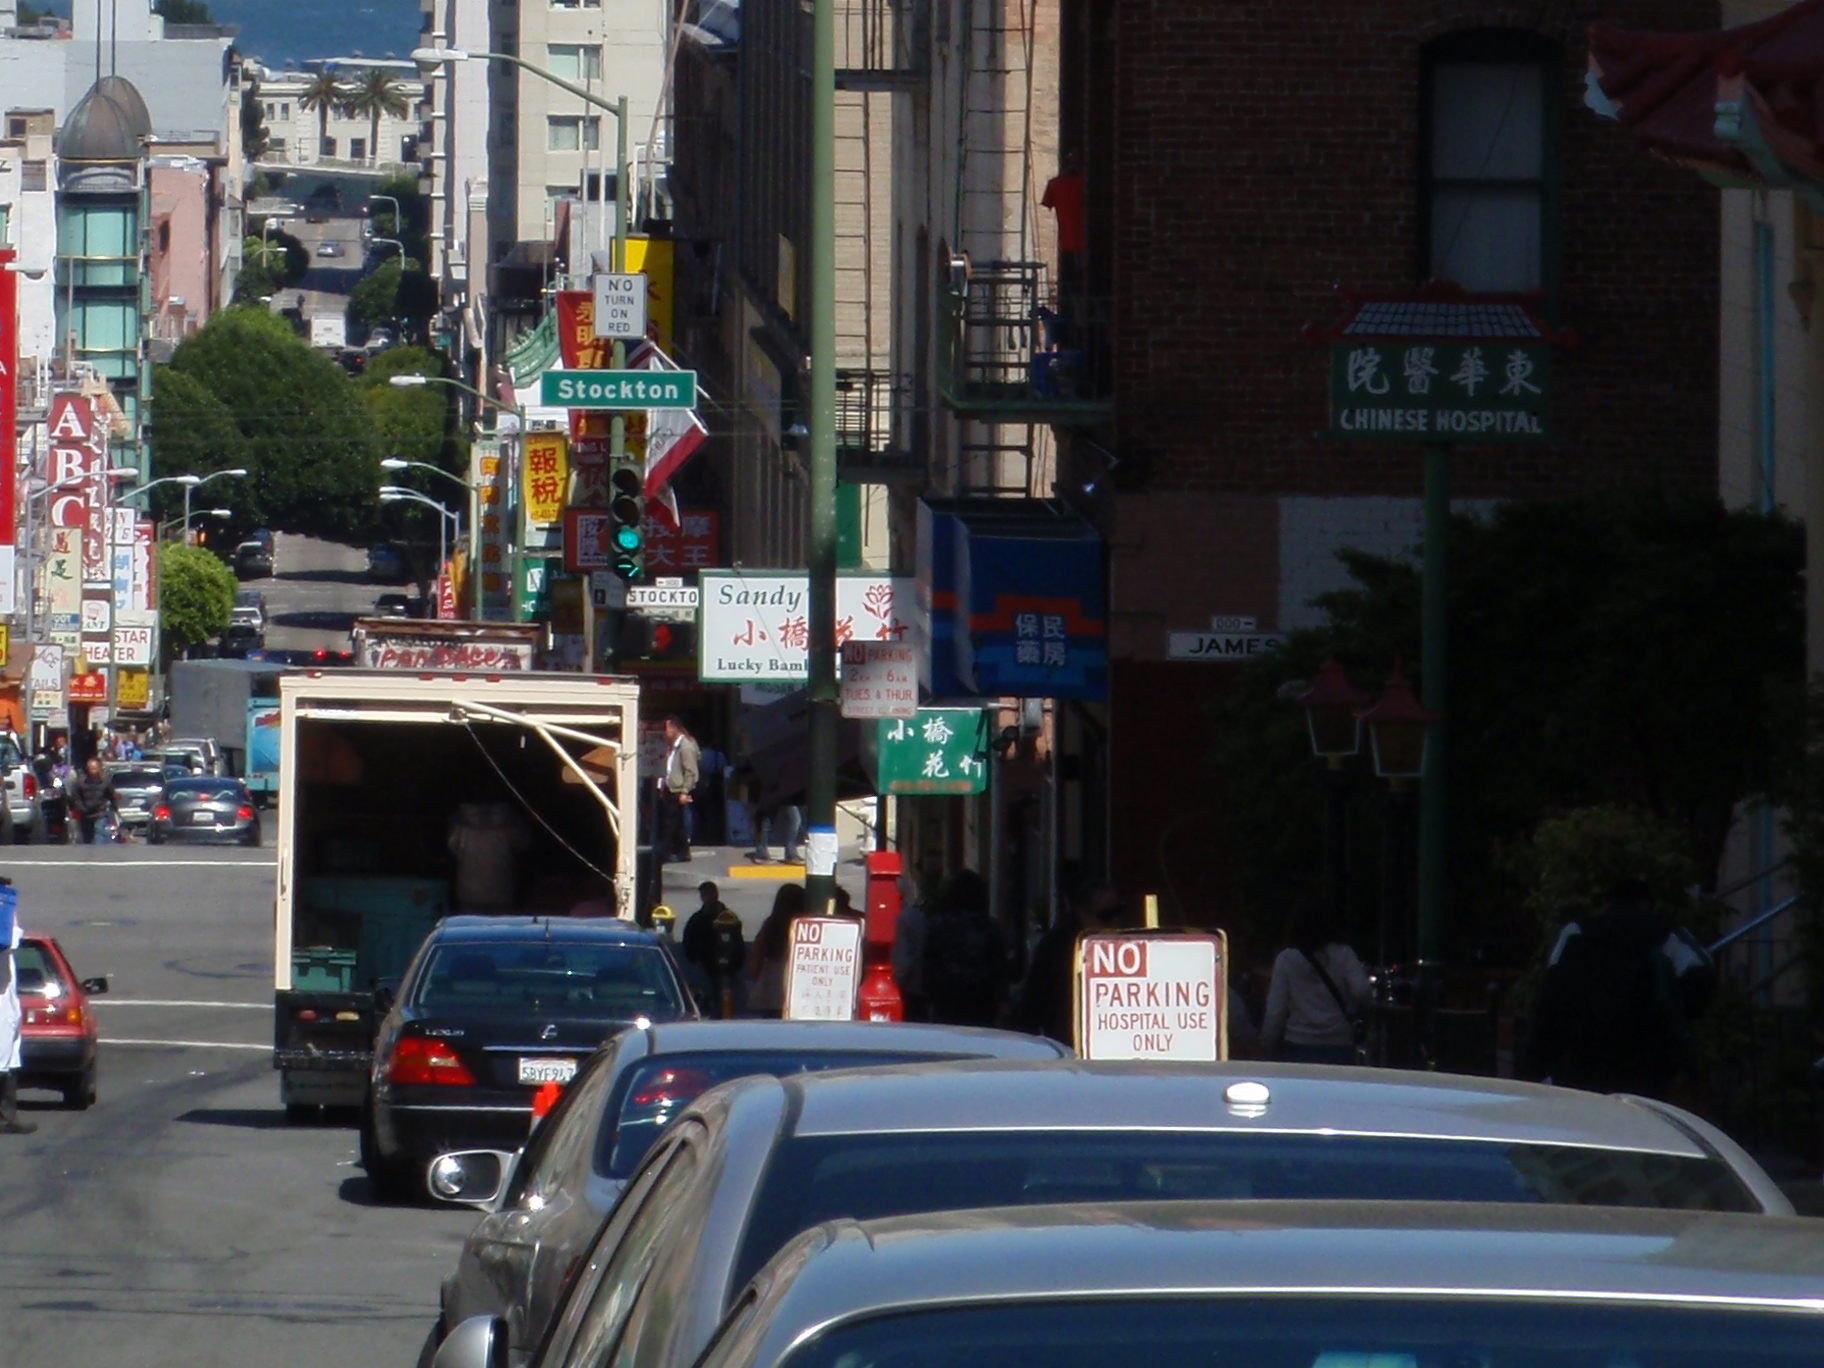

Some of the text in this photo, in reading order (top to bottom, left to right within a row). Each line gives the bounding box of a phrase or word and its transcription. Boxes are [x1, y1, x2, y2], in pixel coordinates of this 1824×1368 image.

[608, 280, 633, 292] NO
[605, 295, 635, 306] TURN
[610, 308, 628, 319] ON
[607, 322, 631, 332] RED
[558, 379, 679, 400] Stockton
[1340, 409, 1543, 433] CHINESE HOSPITAL
[529, 447, 561, 504] 報稅
[717, 658, 763, 673] Lucky
[887, 716, 954, 744] 小橋
[796, 923, 821, 942] NO
[797, 947, 853, 963] PARKING
[1093, 943, 1141, 975] NO
[796, 964, 850, 976] PATIENT USE
[812, 977, 833, 986] ONLY
[1095, 982, 1209, 1007] PARKING
[1098, 1013, 1208, 1030] HOSPITAL USE
[1133, 1034, 1174, 1052] ONLY
